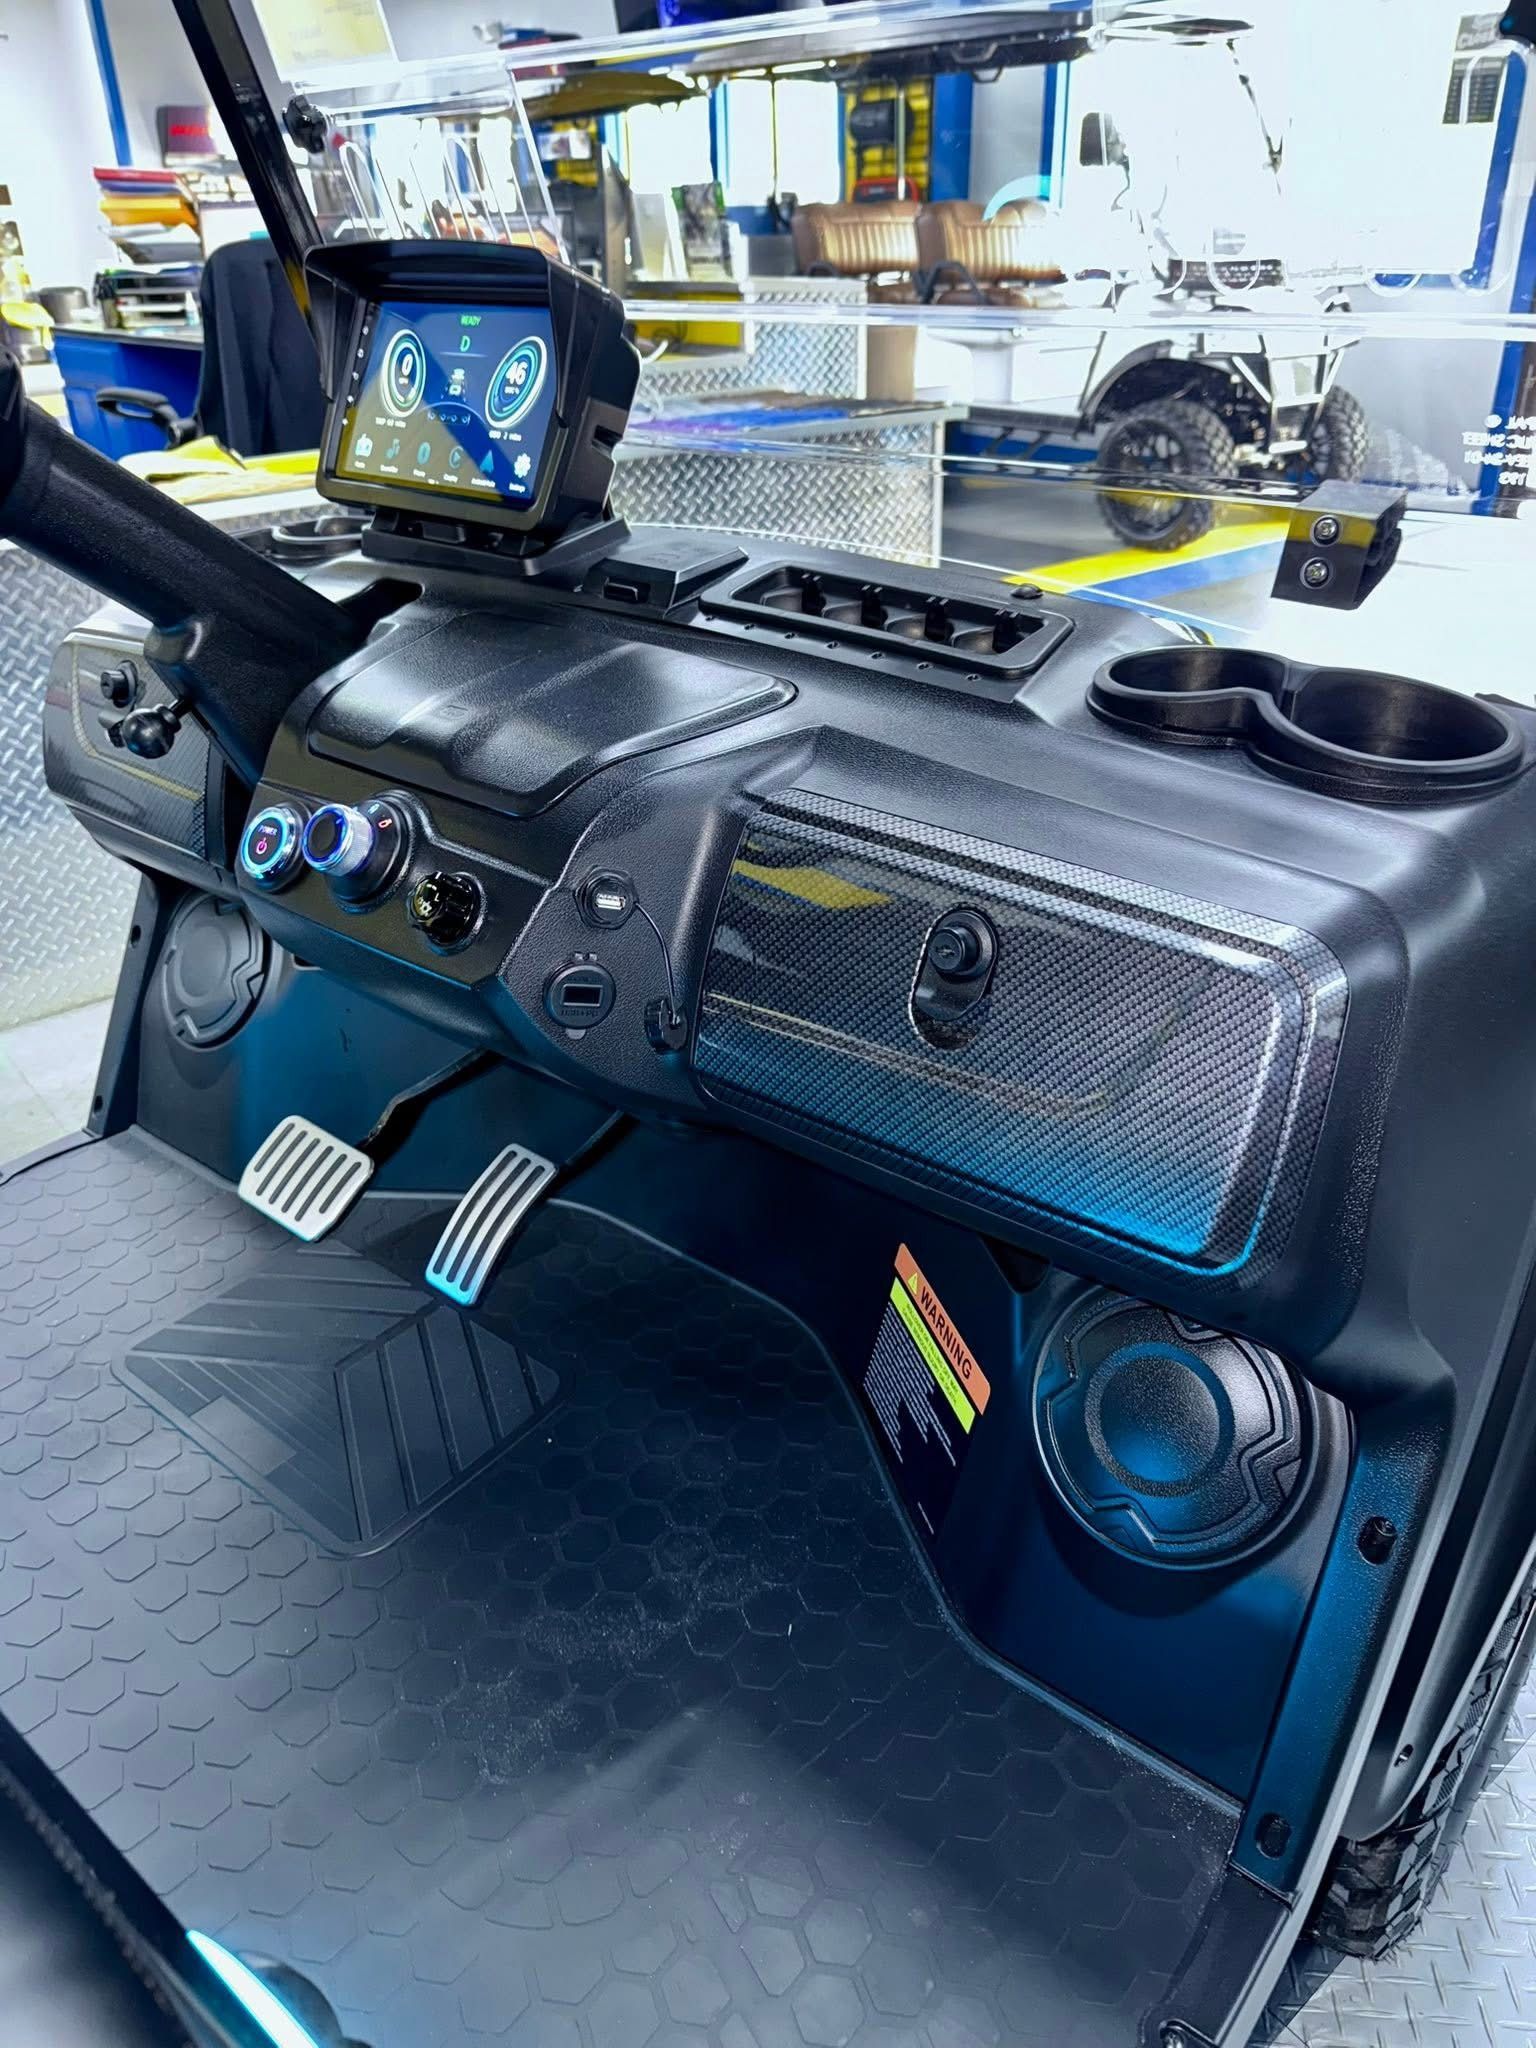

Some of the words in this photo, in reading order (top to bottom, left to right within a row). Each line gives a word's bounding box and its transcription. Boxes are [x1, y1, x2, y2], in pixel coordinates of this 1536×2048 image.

[460, 335, 470, 352] D
[401, 353, 413, 376] 0
[505, 361, 528, 385] 46
[257, 824, 278, 836] POWER
[920, 1286, 972, 1380] WARNING
